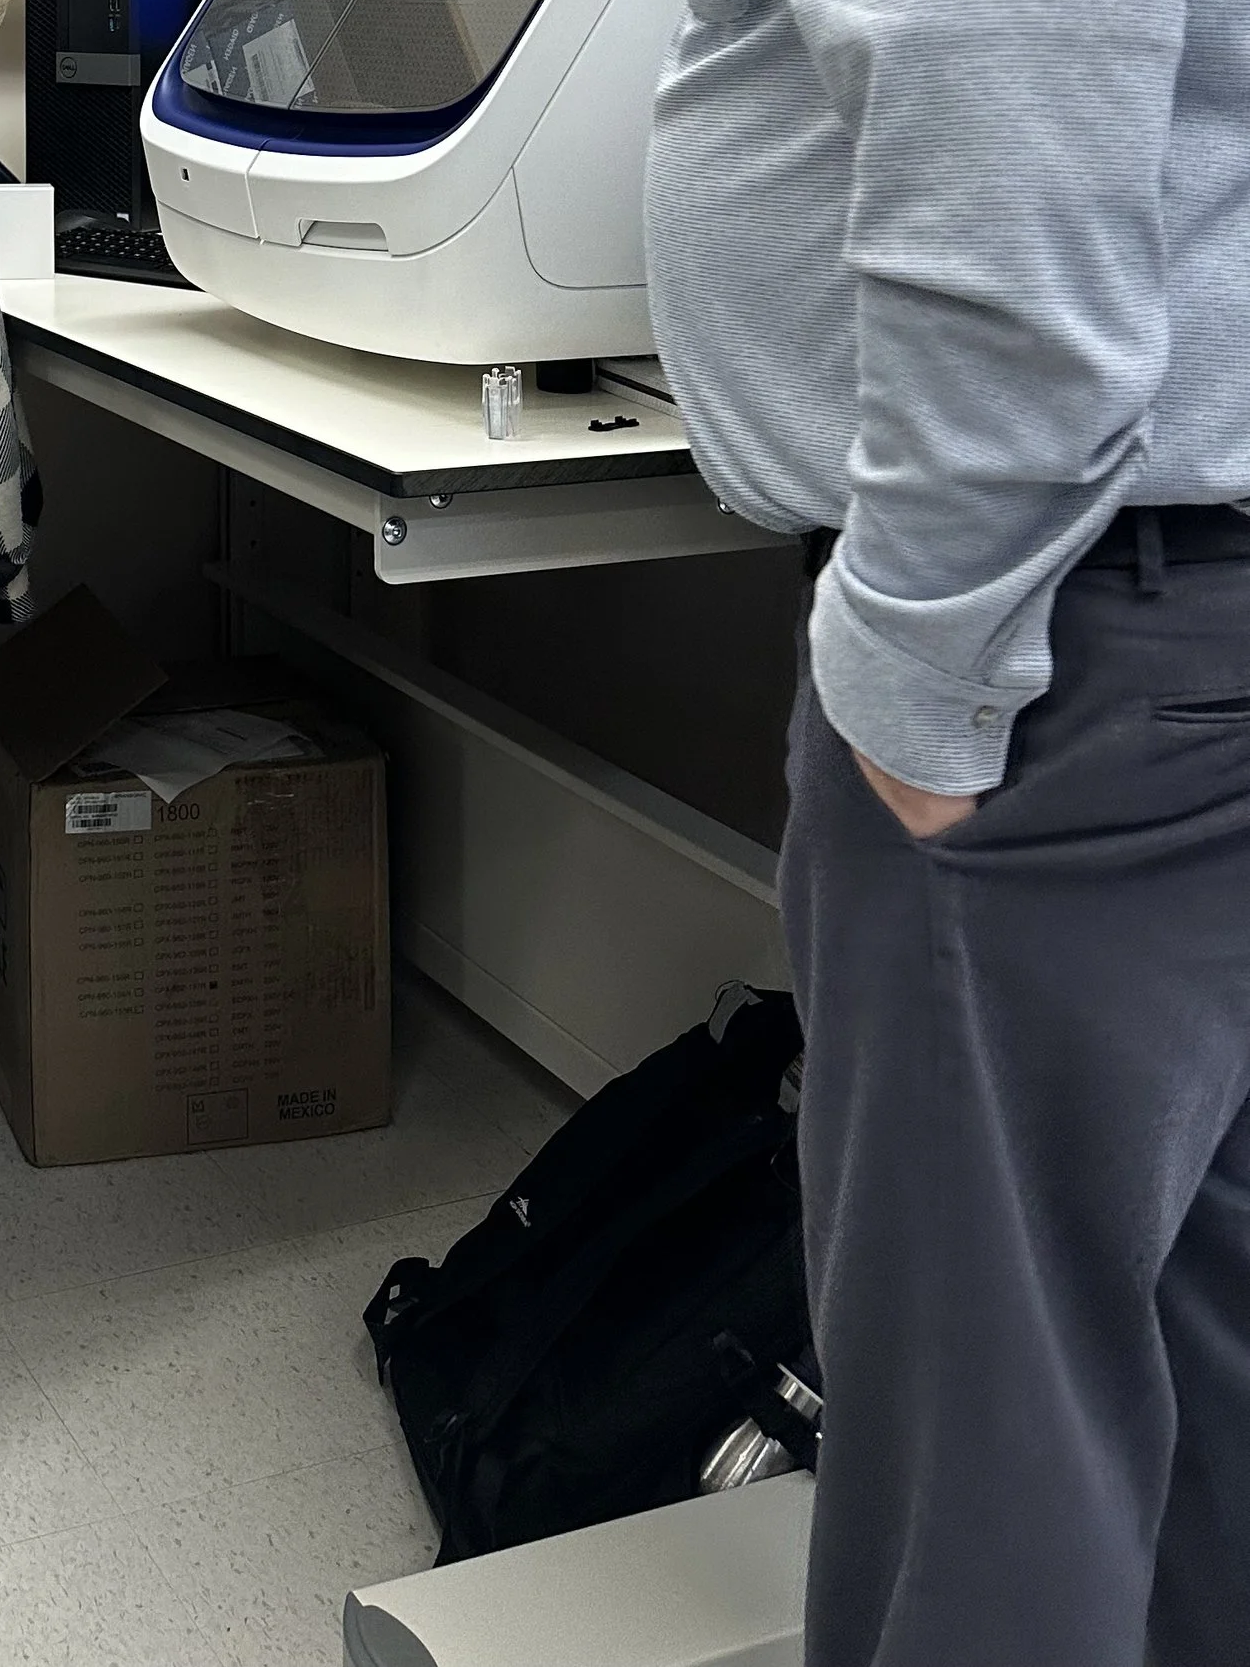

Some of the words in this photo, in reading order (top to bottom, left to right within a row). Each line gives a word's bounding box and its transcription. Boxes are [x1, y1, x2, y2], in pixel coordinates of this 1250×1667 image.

[156, 803, 200, 822] 1800
[277, 1090, 319, 1107] MADE
[322, 1087, 336, 1102] IN
[279, 1102, 336, 1120] MEXICO
